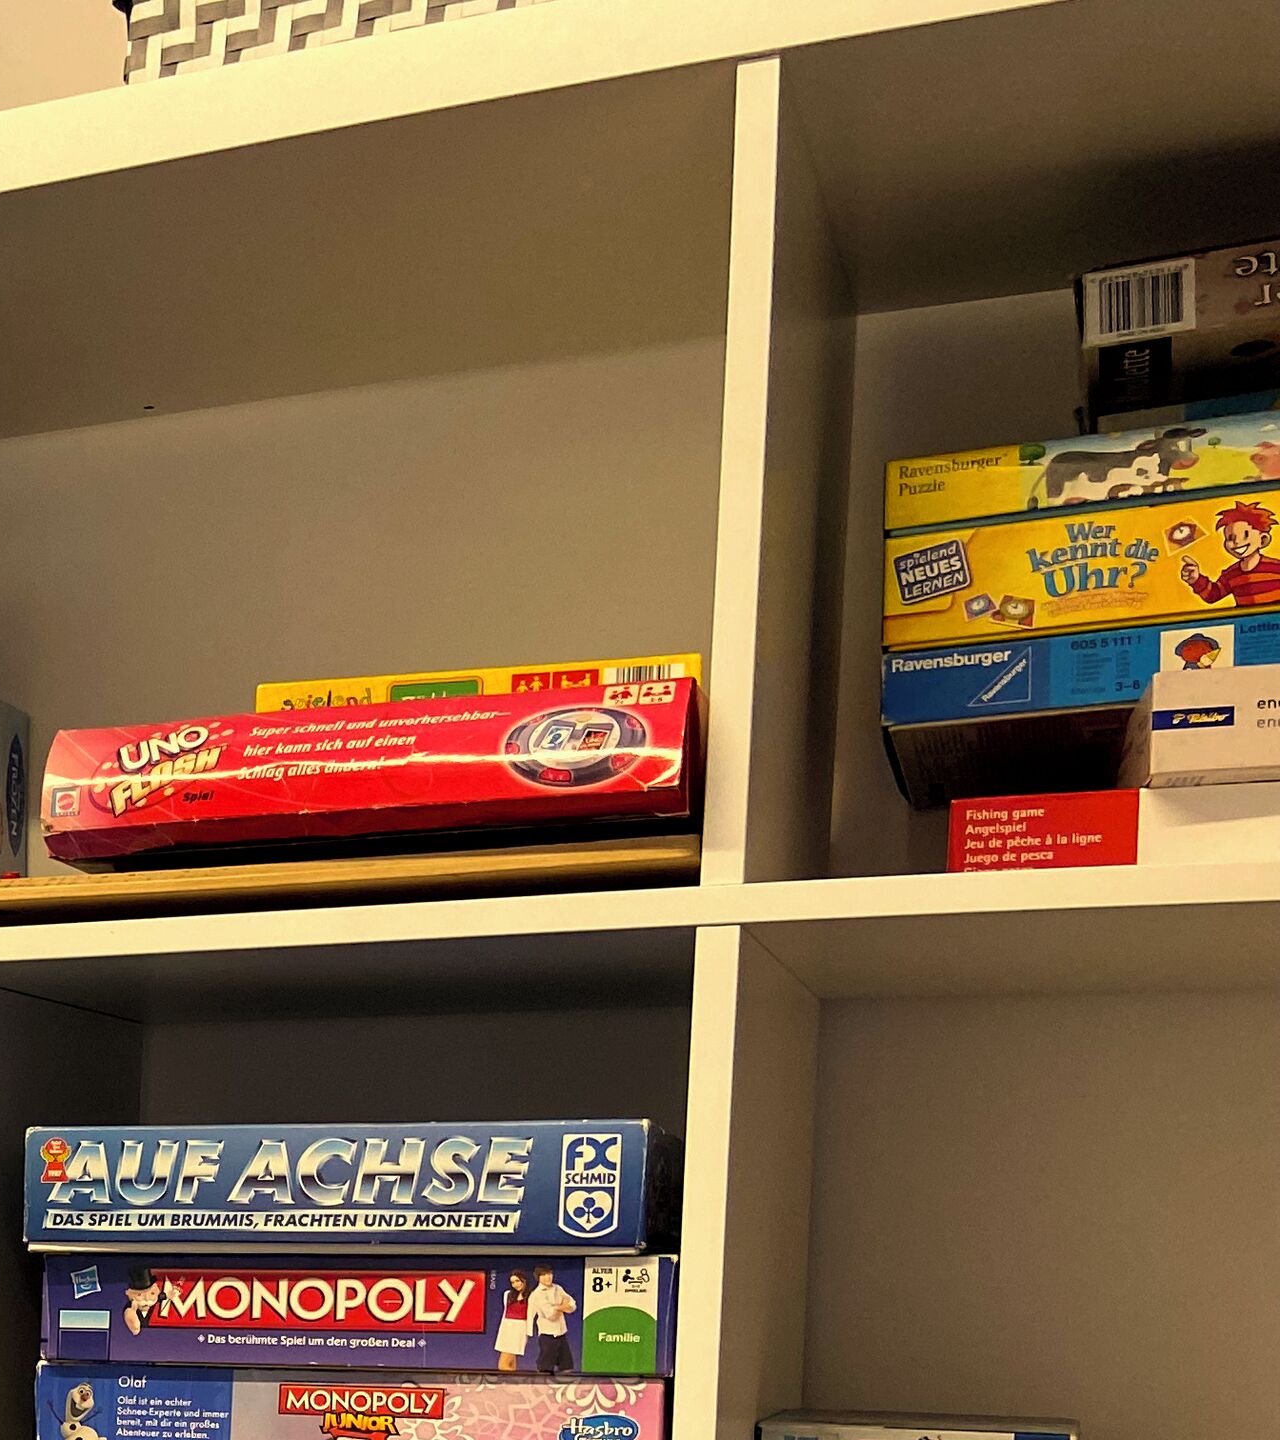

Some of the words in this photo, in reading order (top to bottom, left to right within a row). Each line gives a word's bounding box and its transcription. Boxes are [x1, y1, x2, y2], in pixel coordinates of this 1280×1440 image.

[898, 454, 1002, 479] Ravensburger
[898, 479, 945, 496] Puzzle
[1064, 522, 1116, 542] Wer
[1026, 538, 1119, 564] kennt
[1125, 538, 1160, 562] die
[899, 557, 962, 585] NEUES
[1044, 562, 1147, 598] Uhr?
[904, 571, 964, 598] LERNEN
[891, 649, 1011, 673] Ravensburger
[981, 658, 1028, 702] Ravensburger
[251, 725, 291, 738] Super
[294, 720, 344, 735] schnell
[347, 718, 375, 731] und
[119, 726, 209, 769] UNO
[244, 743, 272, 757] hier
[275, 741, 311, 754] kann
[316, 739, 342, 751] sich
[345, 735, 371, 750] auf
[375, 734, 416, 747] einen
[111, 747, 224, 818] FLASH
[965, 810, 1008, 823] Fishing
[1012, 807, 1045, 821] game
[965, 822, 1027, 836] Angelspiel
[47, 1138, 225, 1205] AUF
[227, 1136, 535, 1205] ACHSE
[565, 1173, 616, 1184] SCHMID
[51, 1213, 85, 1227] DAS
[88, 1213, 134, 1227] SPIEL
[137, 1213, 166, 1227] UM
[169, 1213, 259, 1229] BRUMMIS,
[264, 1213, 360, 1228] FRACHTEN
[363, 1213, 409, 1228] UND
[413, 1213, 510, 1229] MONETEN
[161, 1277, 475, 1322] MONOPOLY
[598, 1332, 640, 1343] Familie
[118, 1376, 147, 1388] Olaf
[285, 1388, 441, 1415] MONOPOLY
[323, 1413, 395, 1433] JUNIOR
[569, 1417, 632, 1440] Hasbro
